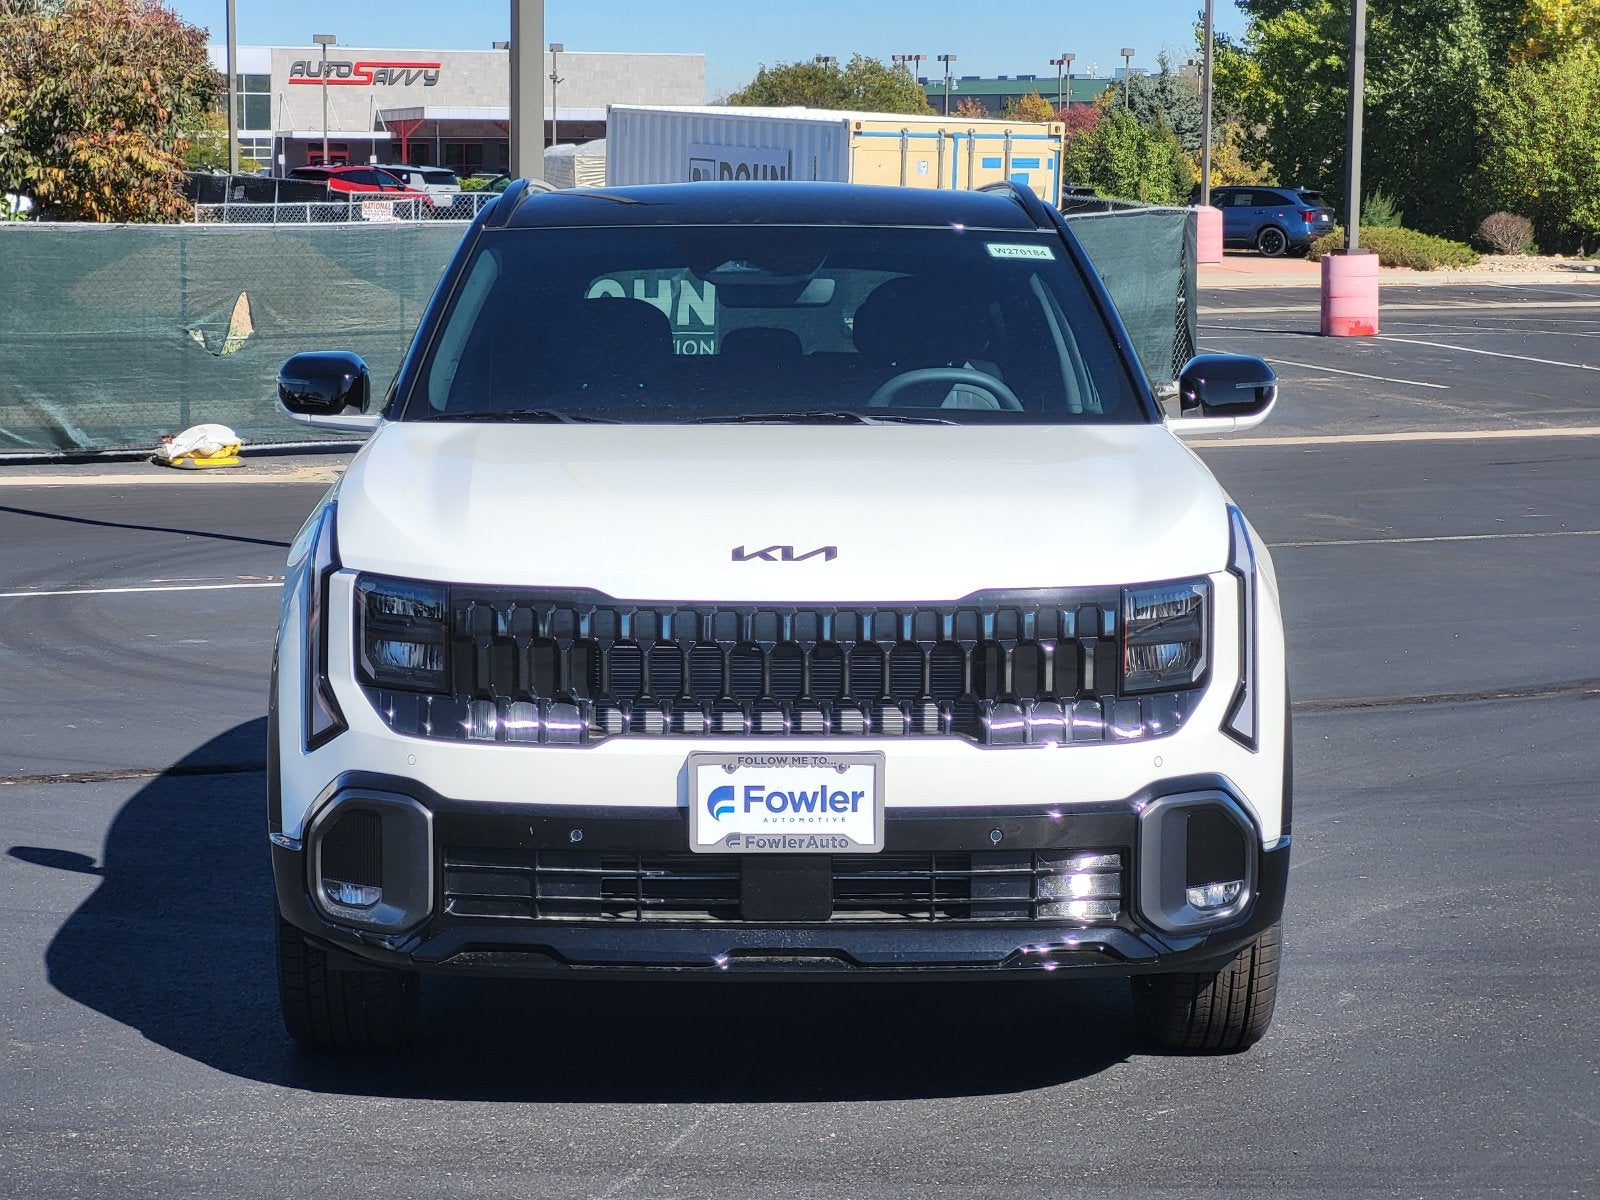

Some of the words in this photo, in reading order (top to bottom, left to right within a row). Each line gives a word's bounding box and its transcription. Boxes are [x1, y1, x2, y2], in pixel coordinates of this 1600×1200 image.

[363, 202, 391, 210] NATIONAL
[731, 545, 838, 562] KIA
[738, 756, 788, 765] FOLLOW
[792, 756, 808, 765] ME
[812, 756, 837, 765] TO...
[743, 784, 865, 813] Fowler
[745, 835, 849, 849] FowlerAuto
